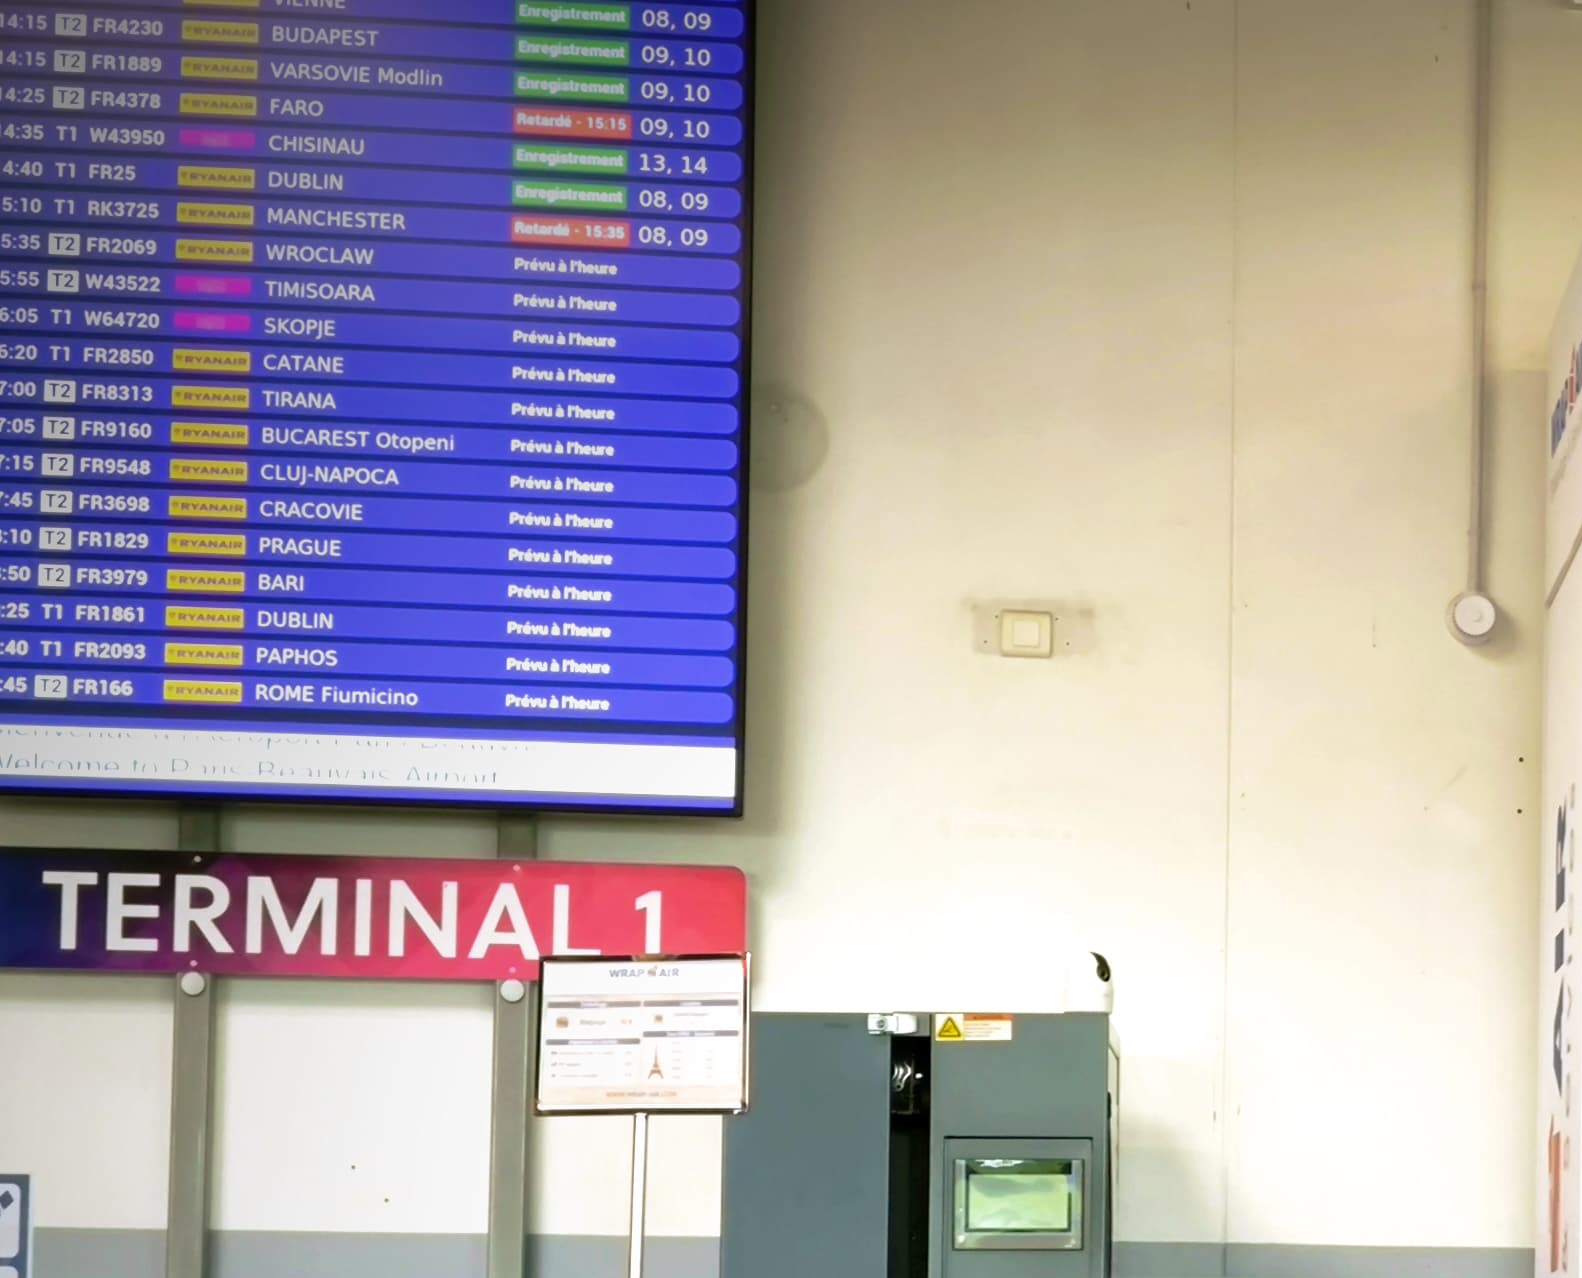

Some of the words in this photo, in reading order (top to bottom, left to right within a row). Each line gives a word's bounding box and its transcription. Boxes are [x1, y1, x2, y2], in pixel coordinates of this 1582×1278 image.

[519, 4, 625, 22] Enregistrement
[684, 12, 711, 30] 09
[57, 17, 81, 35] T2
[94, 18, 163, 35] FR4230
[273, 26, 378, 46] BUDAPEST
[518, 40, 624, 58] Enregistrement
[685, 48, 710, 66] 10
[56, 54, 80, 72] T2
[93, 55, 161, 72] FR1889
[271, 63, 370, 82] VARSOVIE
[378, 68, 442, 85] Modlin
[518, 76, 624, 94] Enregistrement
[685, 84, 710, 102] 10
[58, 90, 79, 104] T2
[91, 91, 160, 108] FR4378
[271, 99, 323, 116] FARO
[588, 117, 626, 130] 15:15
[684, 120, 709, 138] 10
[56, 126, 76, 141] T1
[90, 128, 164, 145] W43950
[269, 136, 364, 155] CHISINAU
[516, 149, 623, 167] Enregistrement
[682, 156, 707, 173] 14
[56, 163, 75, 177] T1
[89, 164, 136, 180] FR25
[269, 172, 343, 190] DUBLIN
[515, 185, 622, 203] Enregistrement
[682, 193, 708, 210] 09
[54, 199, 74, 214] T1
[88, 201, 159, 218] RK3725
[268, 208, 405, 229] MANCHESTER
[586, 225, 624, 239] 15:35
[681, 229, 708, 246] 09
[54, 236, 74, 250] T2
[87, 237, 156, 255] FR2069
[266, 245, 374, 264] WROCLAW
[514, 258, 555, 272] Prévu
[558, 260, 567, 272] à
[52, 270, 76, 287] T2
[86, 274, 160, 292] W43522
[514, 294, 554, 308] Prévu
[557, 296, 566, 308] à
[51, 309, 71, 324] T1
[85, 311, 159, 328] W64720
[265, 318, 335, 339] SKOPJE
[513, 330, 554, 344] Prévu
[557, 332, 565, 345] à
[50, 346, 70, 361] T1
[84, 348, 153, 365] FR2850
[264, 355, 343, 373] CATANE
[512, 367, 553, 380] Prévu
[556, 369, 565, 381] à
[49, 383, 70, 398] T2
[83, 384, 152, 401] FR8313
[263, 391, 336, 409] TIRANA
[512, 403, 552, 417] Prévu
[555, 405, 564, 417] à
[48, 420, 69, 434] T2
[82, 421, 151, 438] FR9160
[262, 428, 370, 447] BUCAREST
[376, 432, 454, 453] Otopeni
[511, 439, 552, 453] Prévu
[555, 441, 564, 453] à
[48, 457, 68, 471] T2
[81, 458, 150, 475] FR9548
[261, 464, 399, 485] CLUJ-NAPOCA
[510, 476, 551, 490] Prévu
[554, 478, 563, 490] à
[46, 494, 67, 508] T2
[79, 495, 149, 512] FR3698
[260, 501, 362, 520] CRACOVIE
[509, 512, 551, 526] Prévu
[553, 514, 562, 526] à
[45, 531, 65, 545] T2
[78, 531, 148, 548] FR1829
[260, 537, 341, 556] PRAGUE
[509, 548, 550, 562] Prévu
[552, 550, 561, 562] à
[44, 568, 64, 582] T2
[77, 568, 147, 585] FR3979
[259, 574, 303, 591] BARI
[508, 585, 549, 599] Prévu
[552, 587, 561, 599] à
[42, 604, 62, 619] T1
[76, 605, 144, 622] FR1861
[258, 611, 333, 629] DUBLIN
[507, 621, 549, 635] Prévu
[551, 623, 560, 635] à
[40, 641, 61, 656] T1
[75, 642, 145, 659] FR2093
[257, 648, 337, 666] PAPHOS
[507, 658, 548, 671] Prévu
[550, 659, 559, 672] à
[40, 679, 61, 692] T2
[74, 679, 133, 696] FR166
[256, 684, 314, 702] ROME
[322, 687, 418, 705] Fiumicino
[506, 694, 547, 708] Prévu
[549, 696, 559, 708] à
[42, 871, 601, 958] TERMINAL
[634, 890, 663, 955] 1
